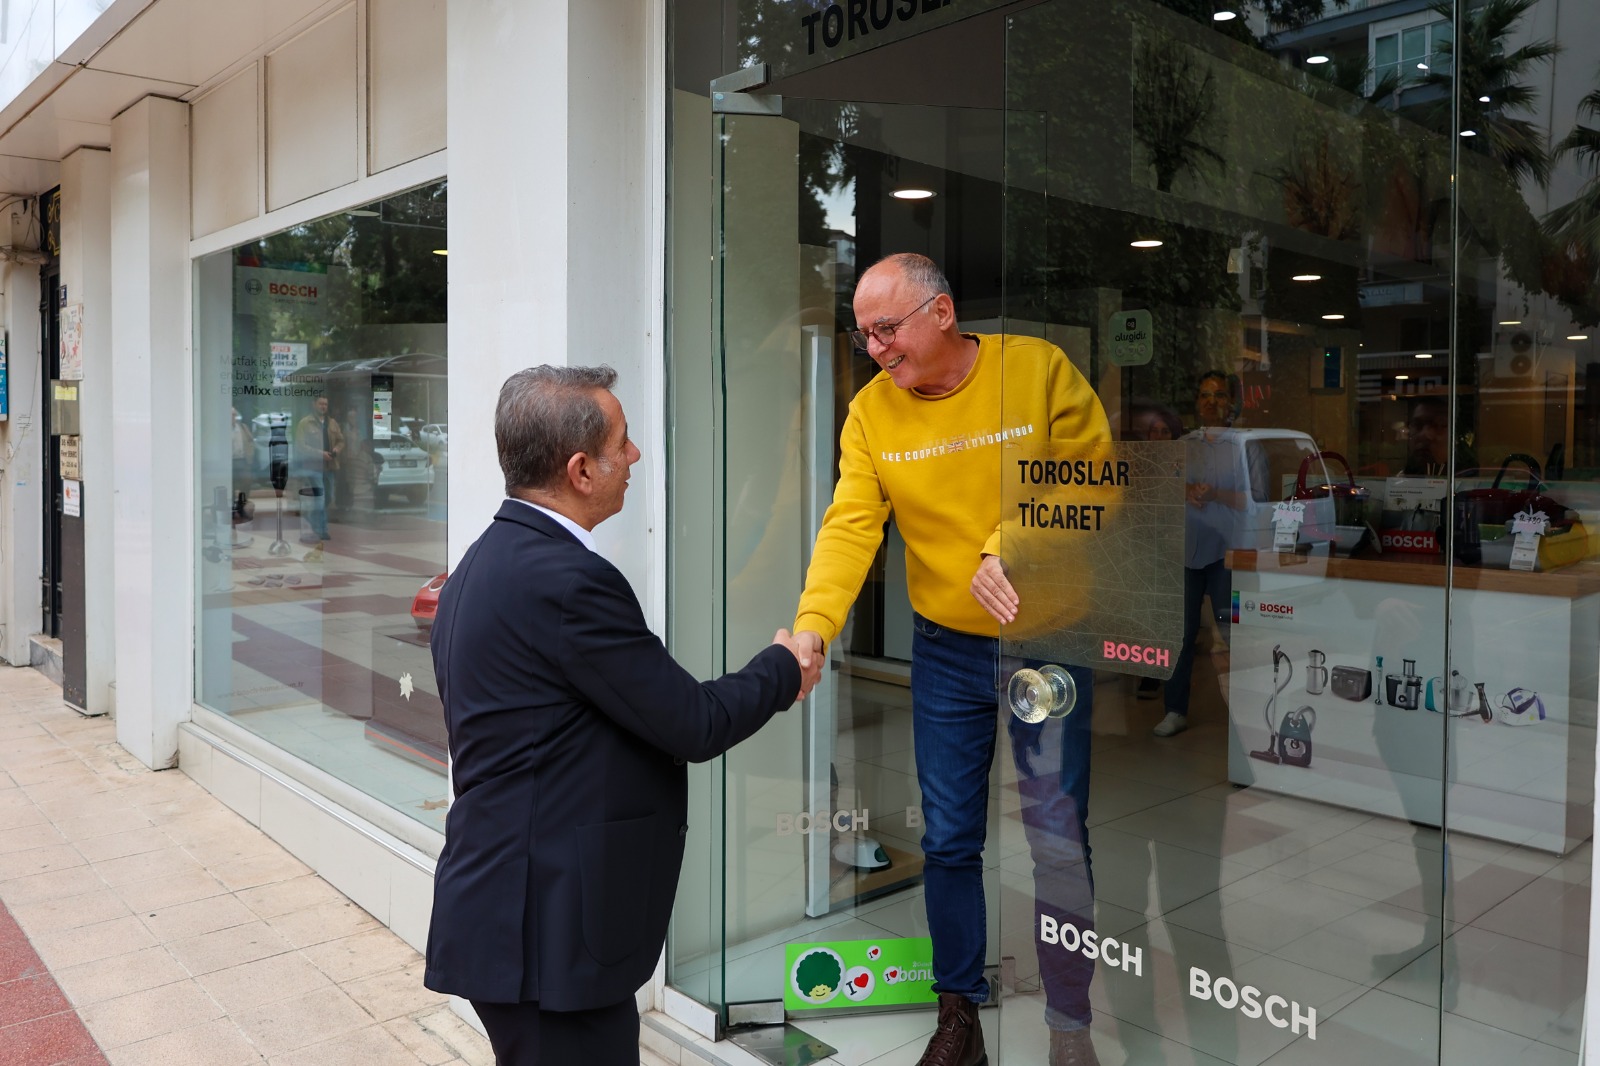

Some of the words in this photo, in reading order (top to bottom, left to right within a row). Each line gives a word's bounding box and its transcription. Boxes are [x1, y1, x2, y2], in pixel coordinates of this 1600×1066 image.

[269, 282, 318, 298] BOSCH
[236, 369, 268, 383] büyük
[220, 383, 271, 397] ErgoMixx
[273, 387, 282, 396] el
[882, 451, 901, 462] LEE
[905, 445, 945, 461] COOPER
[965, 430, 1008, 450] LONDON
[1018, 460, 1130, 486] TOROSLAR
[1018, 497, 1105, 531] TİCARET
[1382, 534, 1434, 549] BOSCH
[1259, 602, 1294, 615] BOSCH
[1103, 640, 1170, 667] BOSCH
[776, 808, 869, 836] BOSCH
[1040, 913, 1143, 977] BOSCH
[898, 966, 936, 982] bonu
[1189, 966, 1317, 1040] BOSCH
